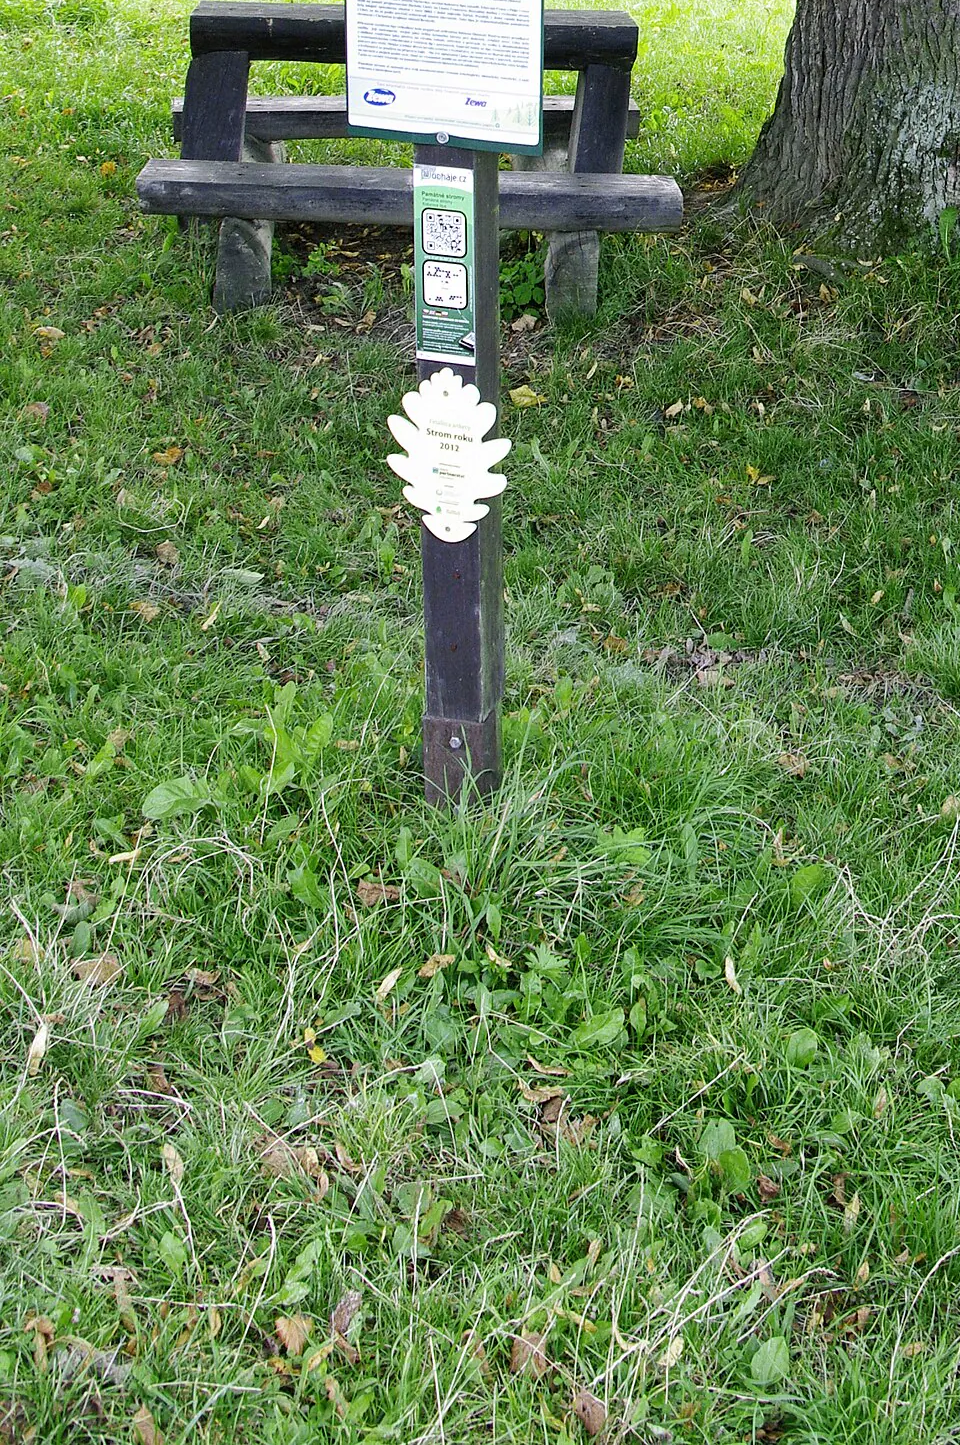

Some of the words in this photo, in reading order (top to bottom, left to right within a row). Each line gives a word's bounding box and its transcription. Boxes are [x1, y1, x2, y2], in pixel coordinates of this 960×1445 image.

[464, 96, 488, 108] Zewa
[426, 428, 451, 439] Strom
[453, 433, 474, 443] roku
[440, 443, 459, 452] 2012
